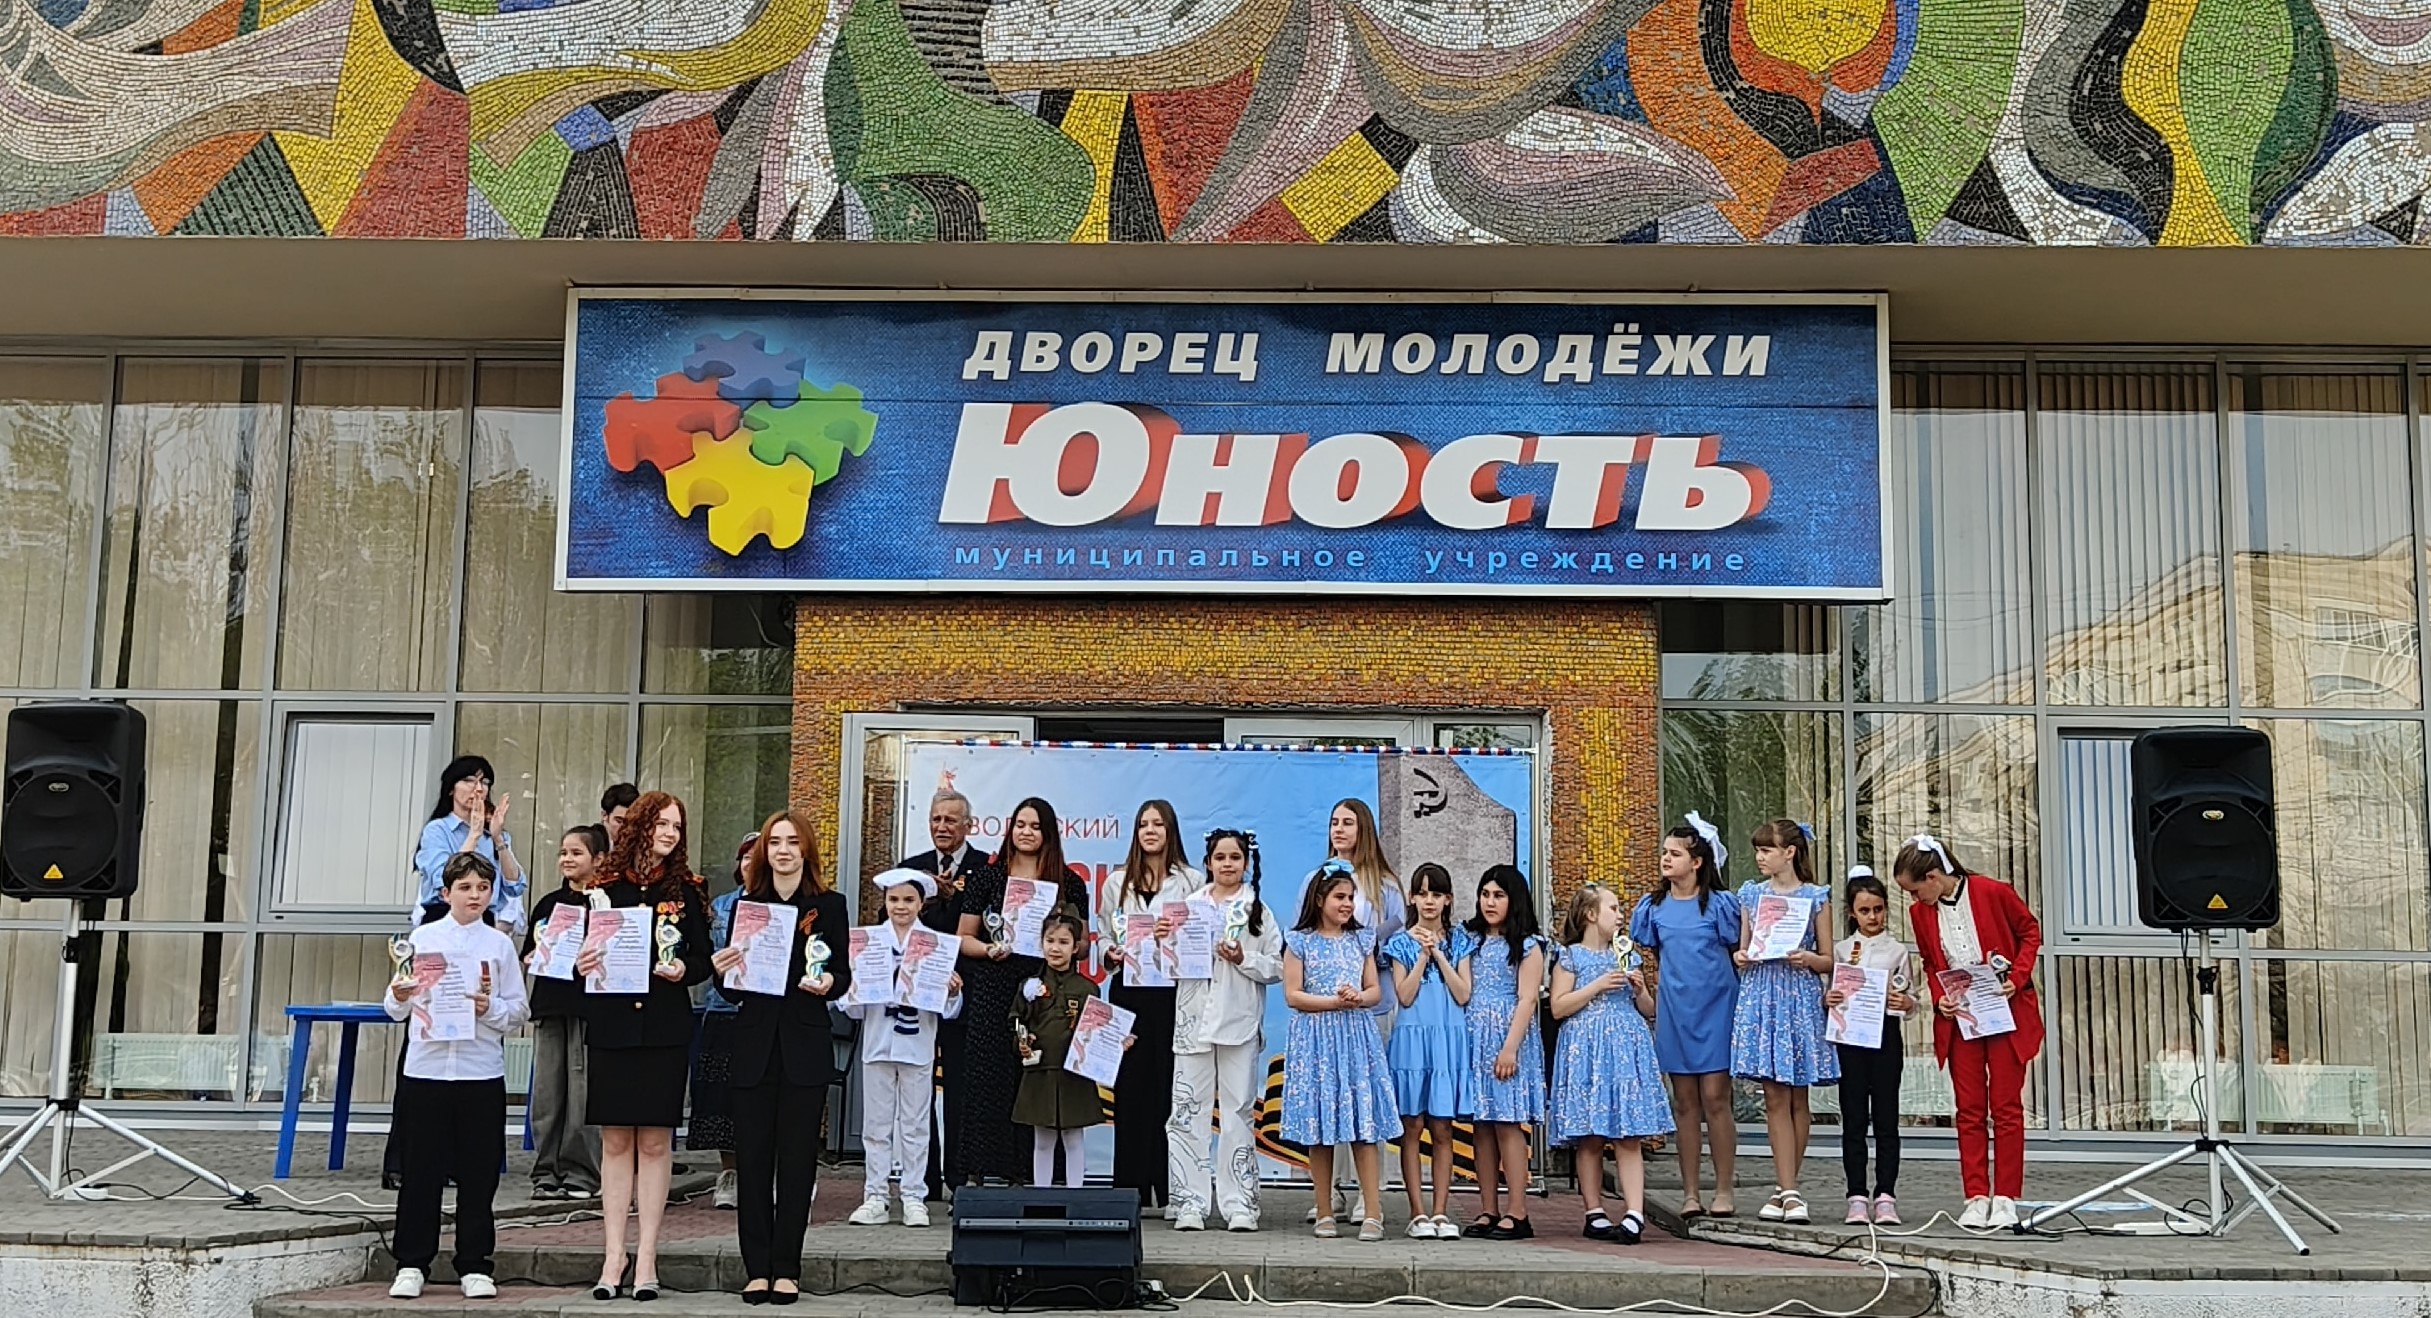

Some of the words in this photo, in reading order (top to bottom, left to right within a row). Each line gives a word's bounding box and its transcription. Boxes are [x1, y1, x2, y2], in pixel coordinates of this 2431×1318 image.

[962, 330, 1260, 381] ДВОРЕЦ
[1325, 323, 1771, 383] МОЛОДЁЖИ
[938, 402, 1760, 531] Юность
[954, 545, 1366, 570] муниципальное
[1424, 549, 1745, 573] учреждение
[969, 813, 1119, 839] ВОЛКИЙ
